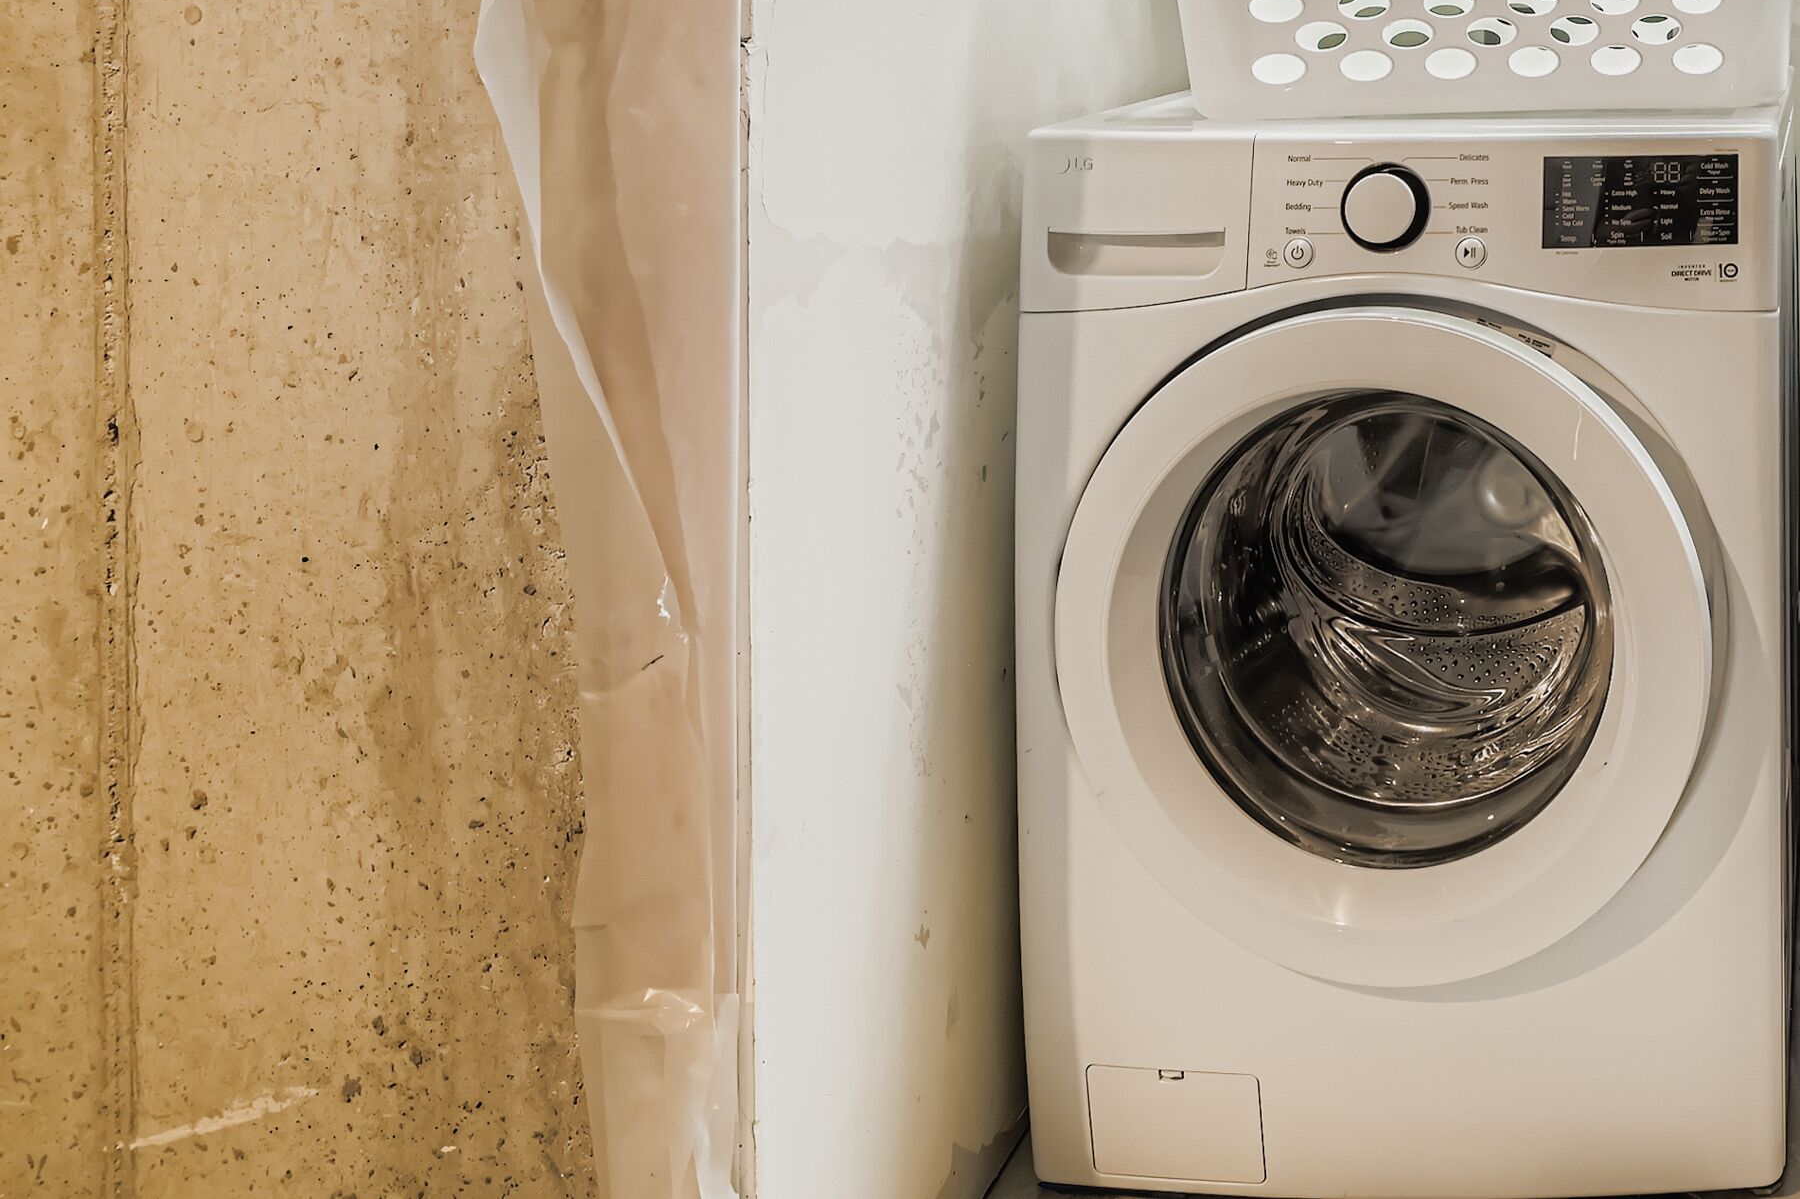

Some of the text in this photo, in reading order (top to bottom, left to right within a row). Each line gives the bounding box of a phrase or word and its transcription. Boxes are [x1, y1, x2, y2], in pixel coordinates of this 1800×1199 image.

[1459, 153, 1490, 161] Delicates
[1286, 179, 1323, 188] Heavy Duty
[1471, 178, 1489, 186] Press
[1699, 187, 1715, 196] Delay
[1285, 203, 1312, 212] Bedding
[1448, 202, 1469, 210] Speed
[1285, 227, 1306, 235] Towels
[1456, 226, 1488, 234] Tub Clean
[1610, 230, 1625, 240] Spin
[1660, 232, 1672, 240] Soil
[1719, 262, 1739, 279] 10
